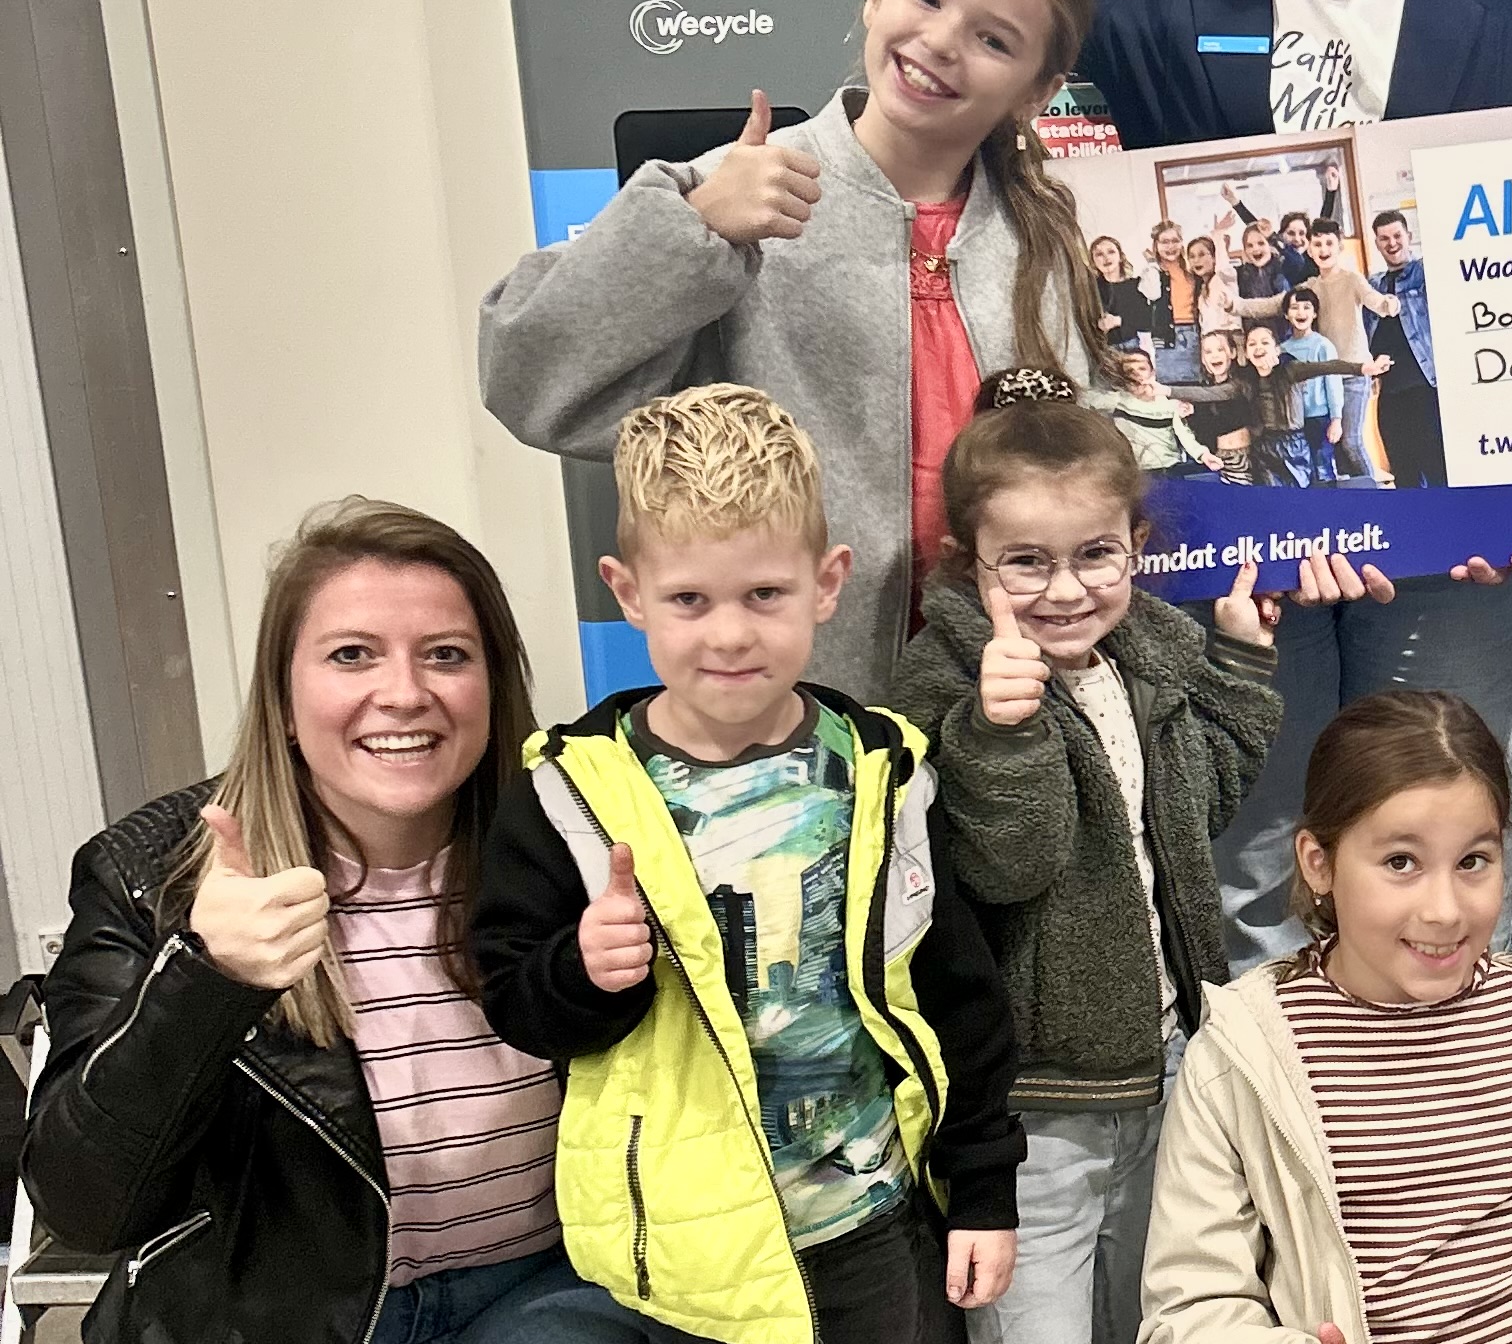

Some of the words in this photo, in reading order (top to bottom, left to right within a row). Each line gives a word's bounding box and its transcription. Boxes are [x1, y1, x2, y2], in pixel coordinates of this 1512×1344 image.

[656, 9, 774, 44] wecycle
[1324, 74, 1352, 107] di
[1039, 122, 1117, 140] statiege
[1221, 536, 1264, 566] elk
[1269, 527, 1330, 561] kind
[1335, 522, 1391, 554] telt.
